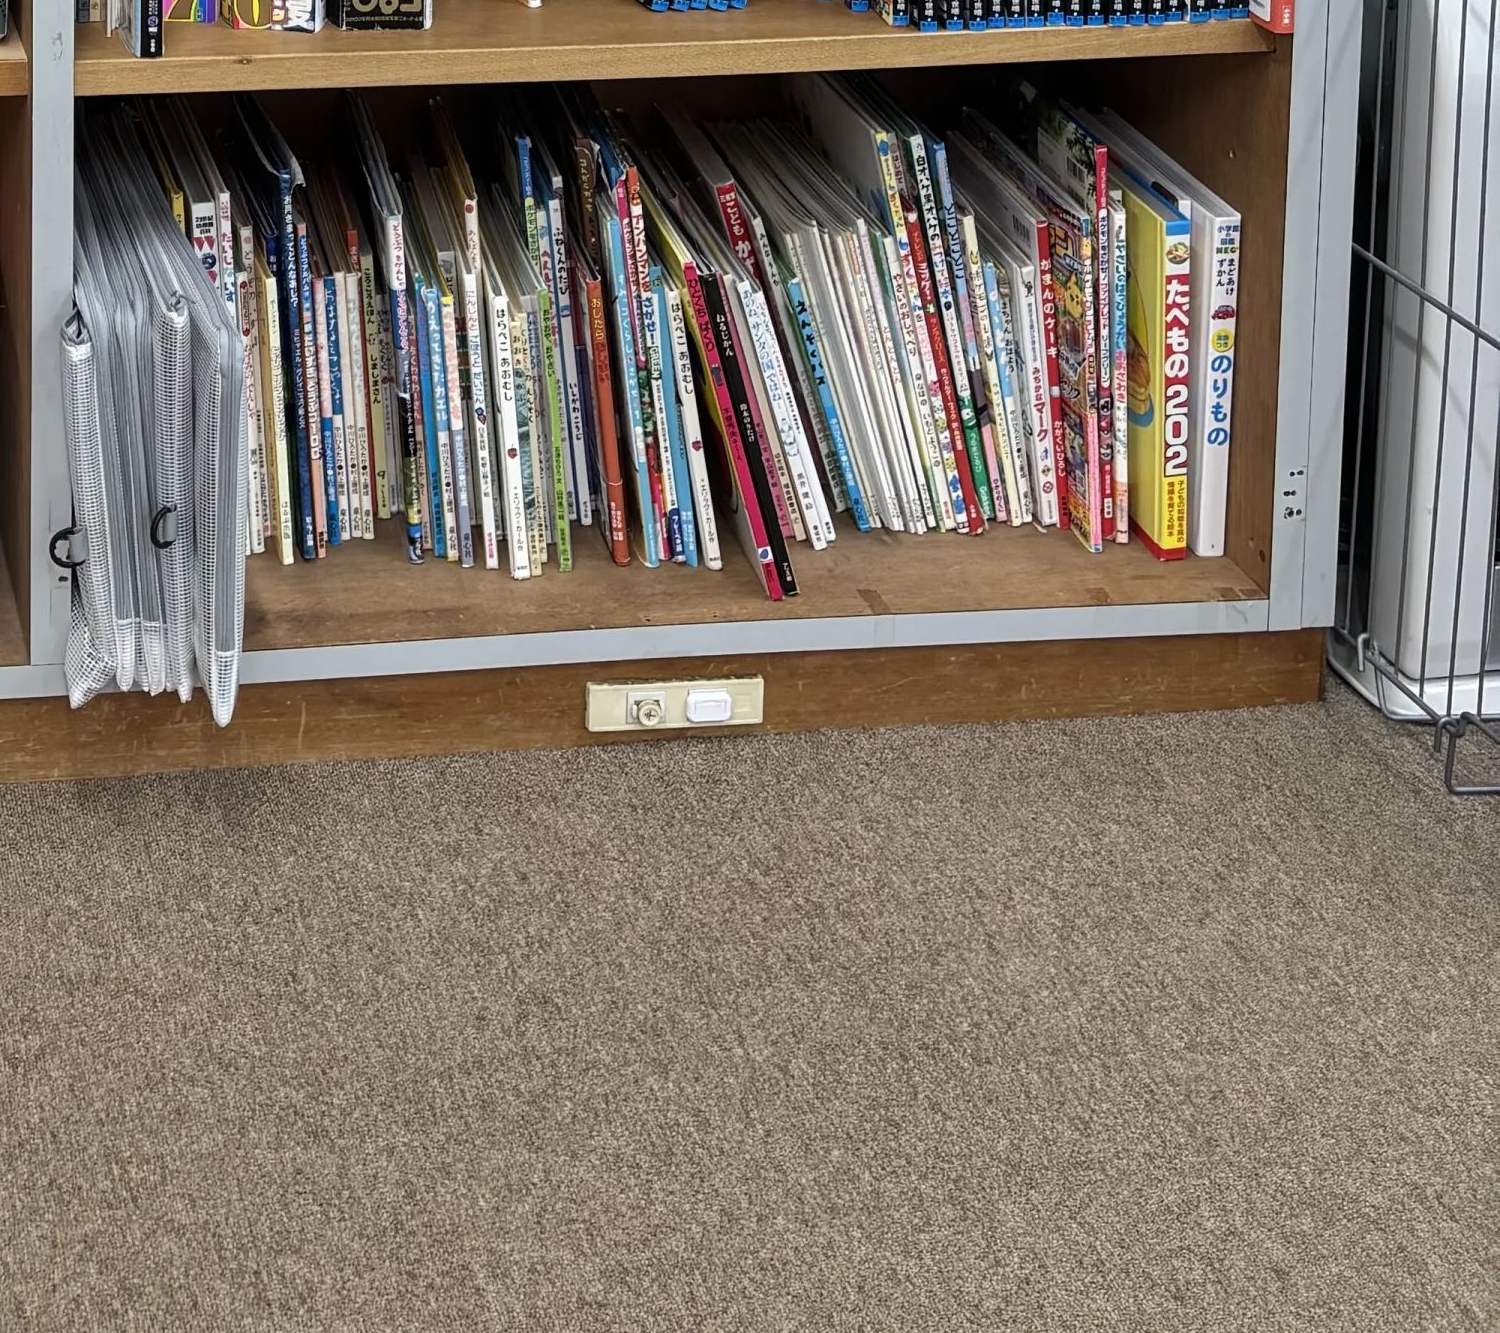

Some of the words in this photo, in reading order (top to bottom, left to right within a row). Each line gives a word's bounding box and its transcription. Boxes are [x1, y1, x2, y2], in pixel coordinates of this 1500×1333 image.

[553, 228, 569, 295] ふねくんのたび
[632, 214, 651, 293] アンパンマンを
[1216, 258, 1226, 287] ずかん
[1226, 258, 1237, 296] まどあけ
[495, 308, 508, 351] はらぺこ
[671, 302, 686, 346] はらぺこ
[892, 272, 918, 358] やさいのおしゃべり
[1040, 257, 1059, 359] がまんのケーキ
[1164, 278, 1190, 379] たべもの
[678, 351, 694, 395] あおむし
[795, 299, 826, 386] えんそくバス
[500, 357, 513, 402] あおむし
[1207, 354, 1233, 447] のりもの
[1054, 420, 1066, 477] かがくいひろし
[1164, 383, 1189, 476] 202
